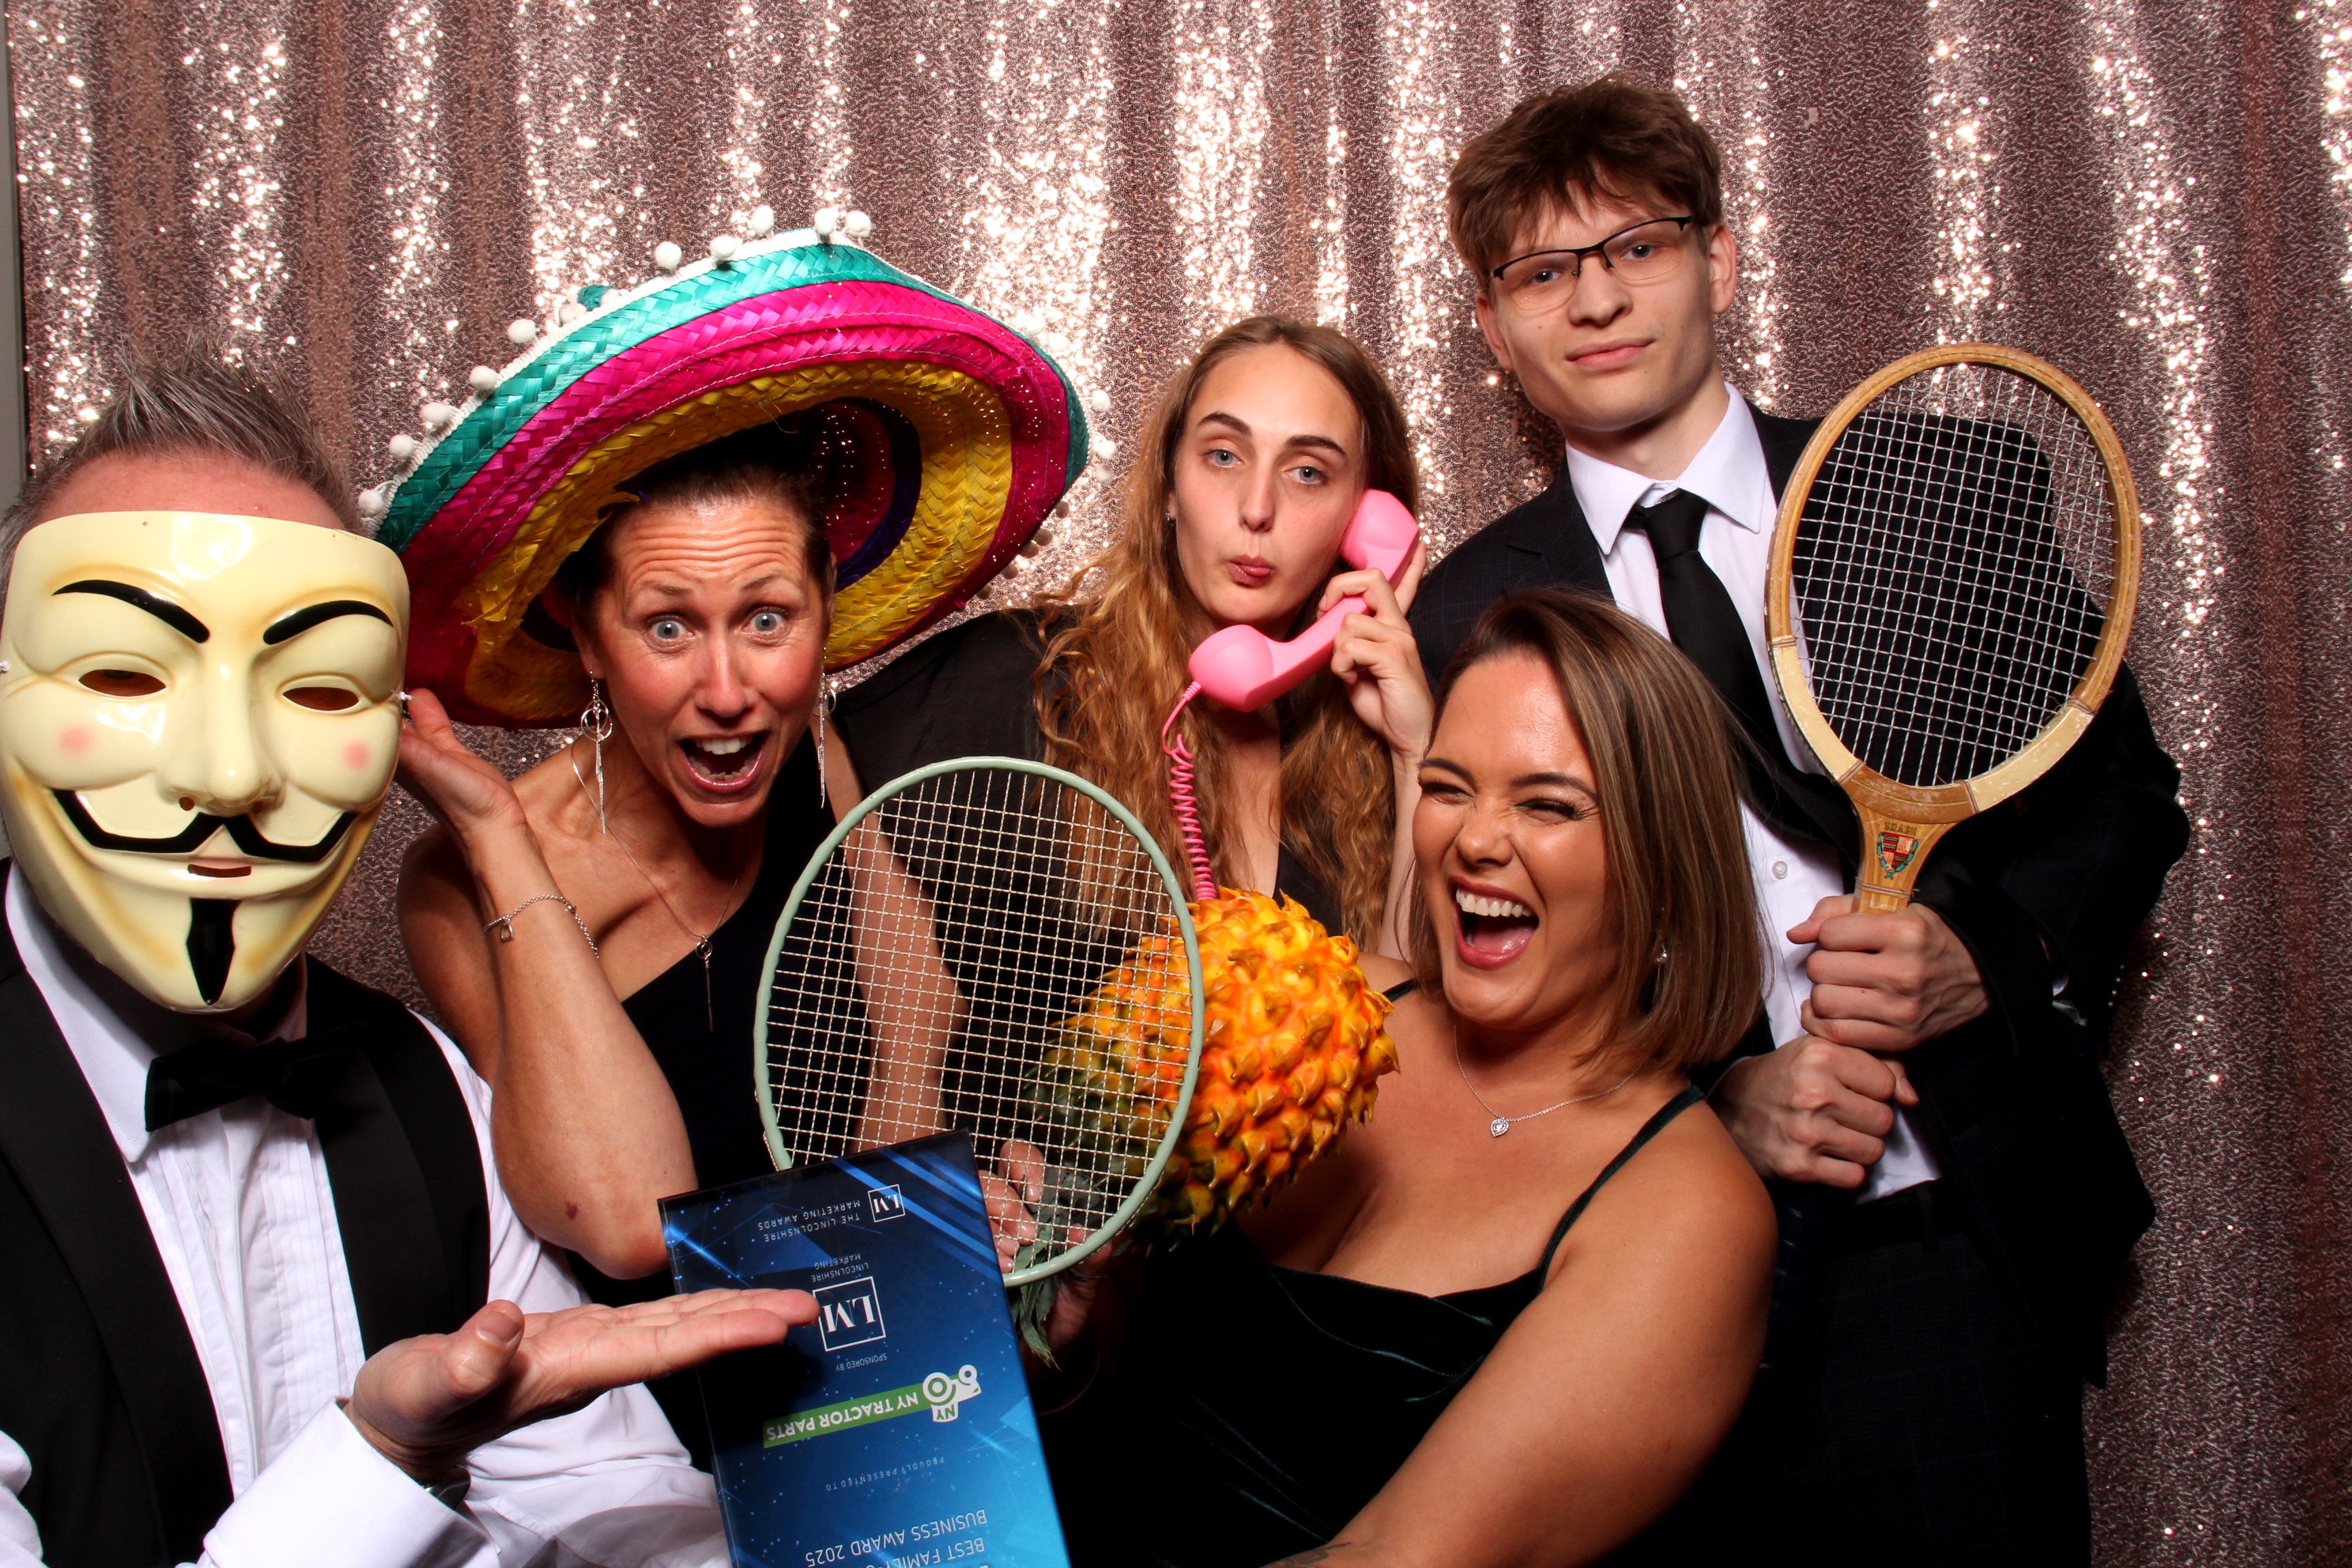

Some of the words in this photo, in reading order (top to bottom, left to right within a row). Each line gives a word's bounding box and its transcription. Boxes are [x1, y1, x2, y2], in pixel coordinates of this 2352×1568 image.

[803, 1200, 860, 1220] MARKETING
[872, 1194, 900, 1213] LM
[758, 1214, 798, 1230] AWARDS
[842, 1213, 860, 1224] THE
[764, 1218, 836, 1242] LINCOLNSHIRE
[815, 1253, 861, 1270] MARKETING
[812, 1262, 869, 1282] LINCOLNSHIRE
[821, 1294, 877, 1334] LM
[836, 1363, 845, 1371] BY
[846, 1352, 887, 1369] SPONSORED
[896, 1392, 919, 1409] NY
[819, 1399, 894, 1428] TRACTOR
[936, 1404, 956, 1421] NY
[766, 1417, 816, 1441] PARTS
[901, 1456, 945, 1474] PROUDLY
[826, 1482, 838, 1491] TO
[841, 1468, 898, 1488] PRESENTED
[911, 1509, 987, 1541] BUSINESS
[851, 1529, 905, 1556] AWARD
[947, 1537, 985, 1561] BEST
[805, 1544, 845, 1567] 2025
[863, 1548, 941, 1568] FAMILY-
